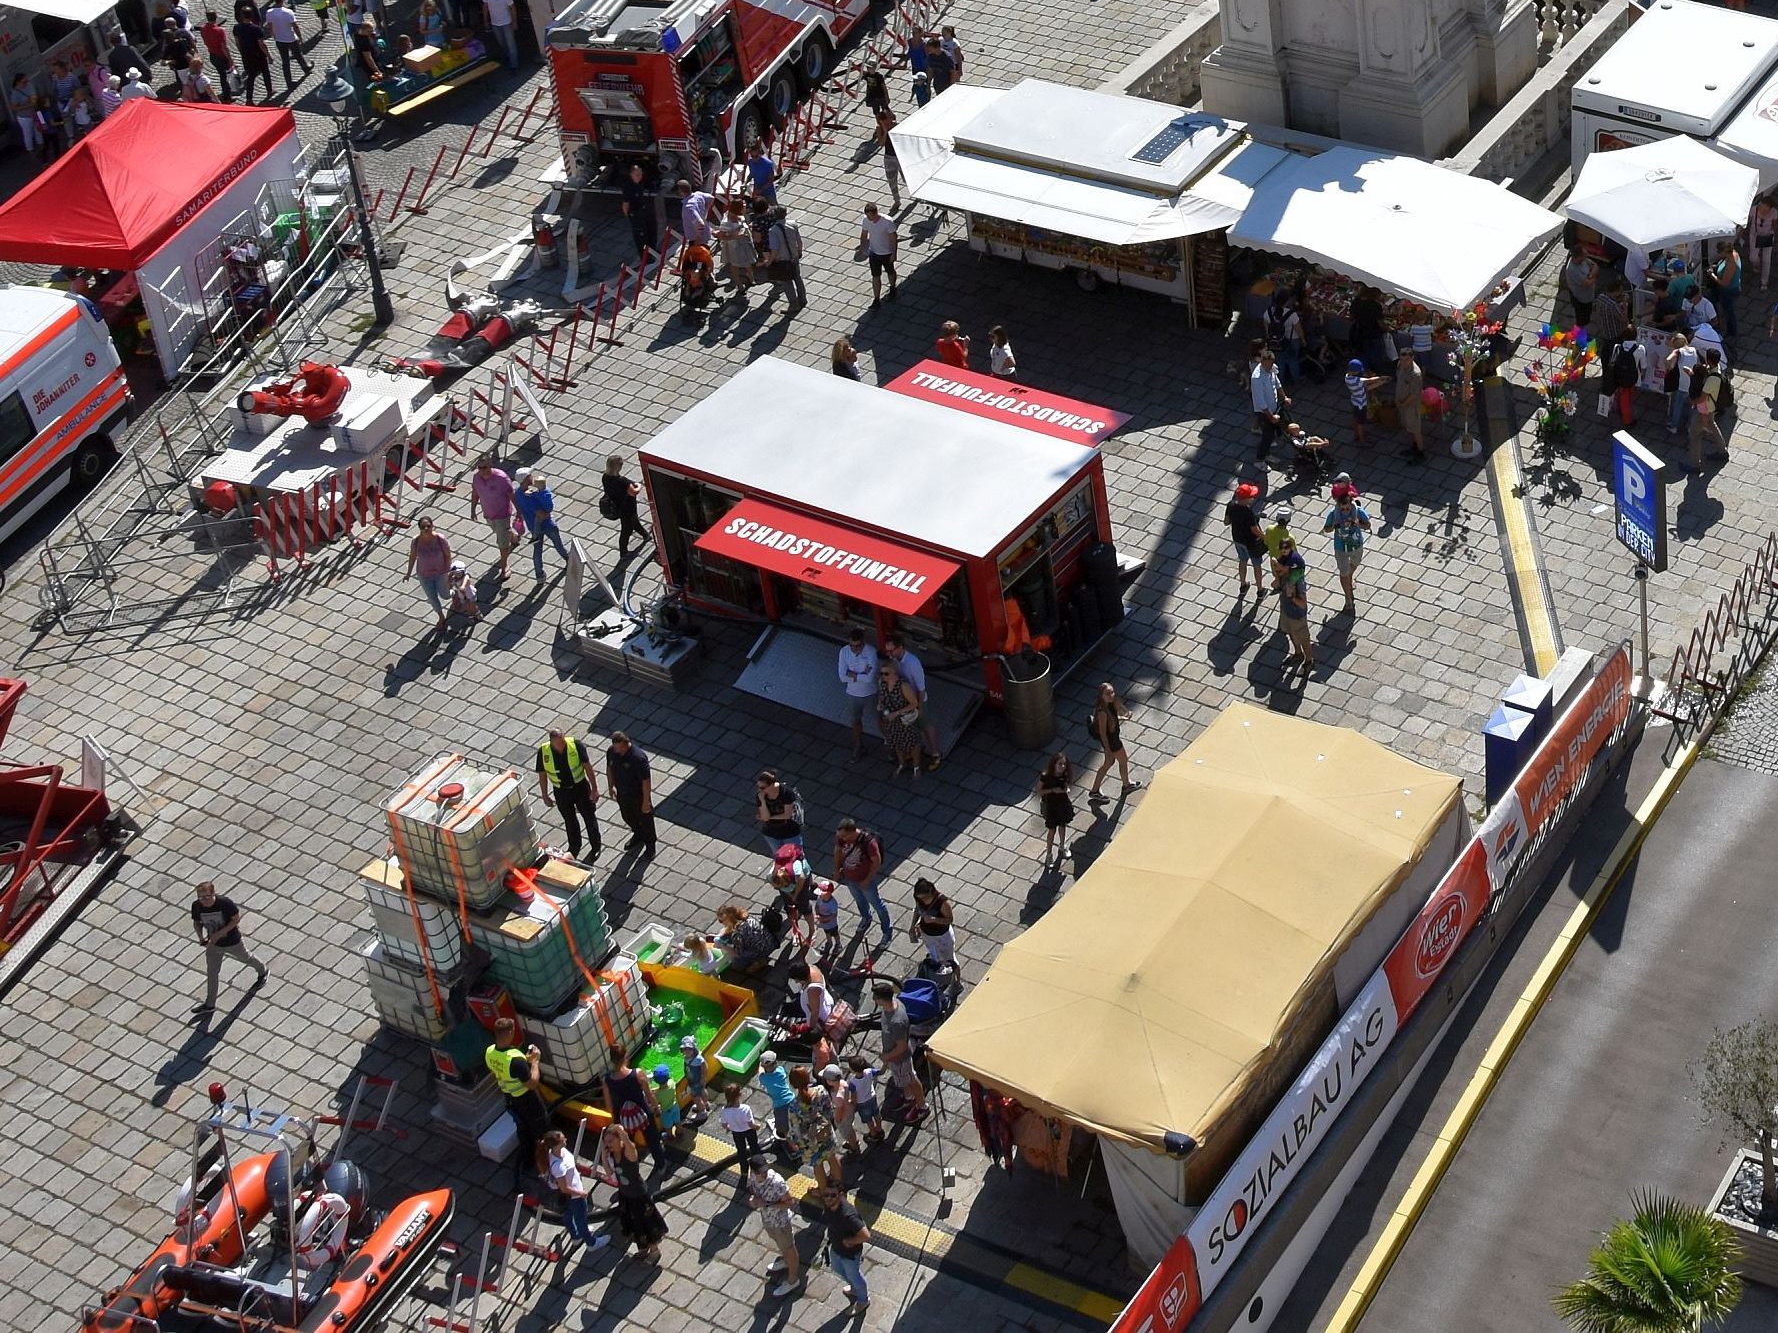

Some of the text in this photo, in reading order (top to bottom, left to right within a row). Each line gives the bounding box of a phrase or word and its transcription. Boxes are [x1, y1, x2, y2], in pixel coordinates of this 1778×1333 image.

[174, 148, 258, 227] SAMARITERBUND
[34, 388, 48, 405] DIE
[36, 372, 82, 414] JOHANNITER
[58, 392, 109, 441] AMBULANCE
[911, 372, 1106, 435] SCHADSTOFFUNFALL
[724, 517, 928, 594] SCHADSTOFFUNFALL
[1620, 514, 1654, 551] PARKEN
[1640, 542, 1656, 566] CITY
[1528, 677, 1625, 814] WIEN ENERGIE
[1206, 1007, 1385, 1267] SOZIALBAU AG
[395, 1210, 432, 1248] VALIANT
